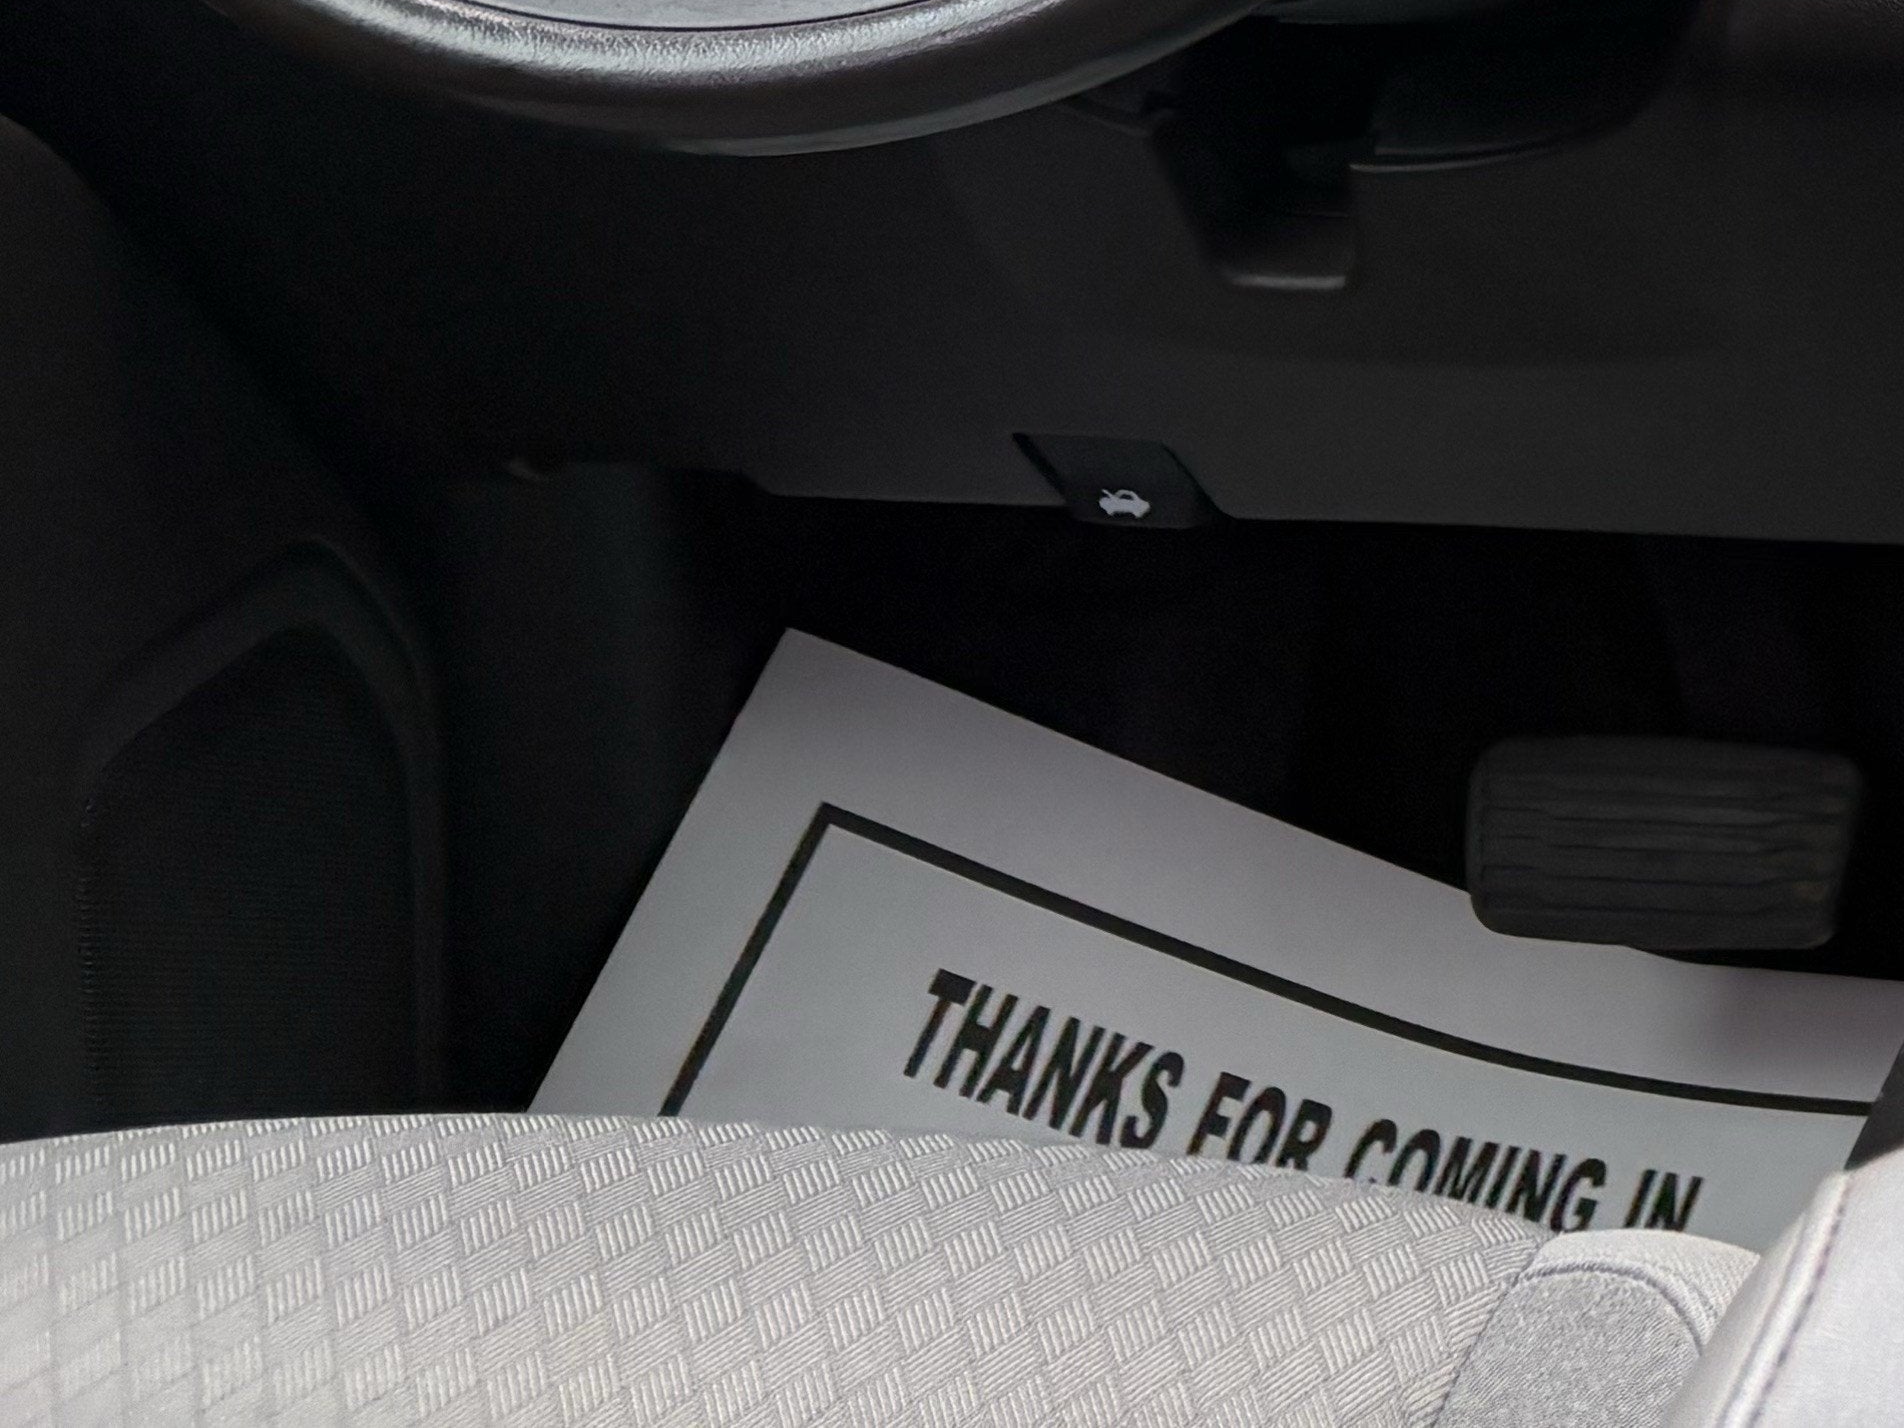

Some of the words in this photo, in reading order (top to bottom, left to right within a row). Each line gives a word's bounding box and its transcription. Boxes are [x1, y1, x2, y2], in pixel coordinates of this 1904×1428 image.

[904, 967, 1183, 1148] THANKS
[1186, 1072, 1333, 1168] FOR
[1345, 1117, 1606, 1234] COMING
[1625, 1168, 1704, 1230] IN
